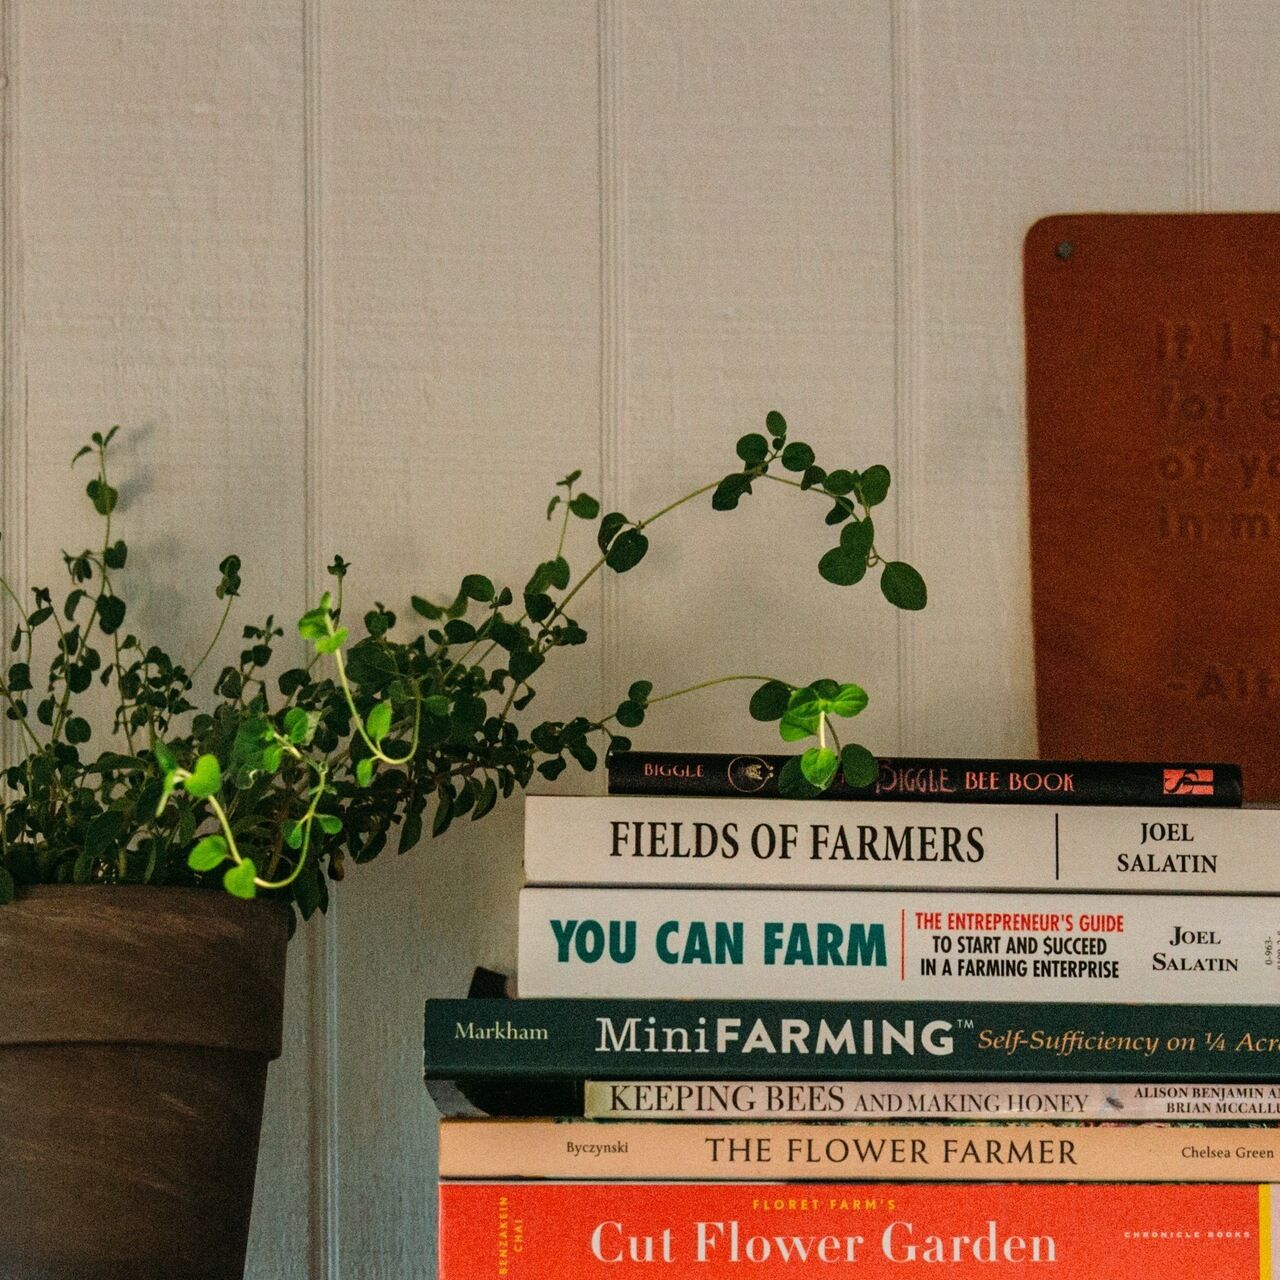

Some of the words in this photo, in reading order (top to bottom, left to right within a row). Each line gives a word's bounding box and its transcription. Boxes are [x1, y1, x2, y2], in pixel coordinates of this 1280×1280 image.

[1160, 383, 1233, 421] for
[1158, 443, 1209, 482] of
[1158, 505, 1204, 540] in
[643, 763, 705, 779] BIGGLE
[965, 771, 1000, 791] BEE
[1009, 772, 1075, 792] BOOK
[610, 820, 740, 859] FIELDS
[751, 823, 799, 860] OF
[810, 824, 985, 863] FARMERS
[1140, 822, 1194, 845] JOEL
[1117, 853, 1218, 874] SALATIN
[915, 912, 942, 930] THE
[947, 912, 1073, 932] ENTREPRENEUR'S
[1079, 914, 1124, 933] GUIDE
[550, 919, 637, 964] YOU
[656, 920, 743, 965] CAN
[764, 922, 888, 967] FARM
[932, 935, 952, 953] TO
[957, 936, 1001, 954] START
[1006, 936, 1038, 955] AND
[1169, 926, 1222, 947] JOEL
[921, 958, 936, 976] IN
[941, 958, 952, 976] A
[958, 959, 1028, 977] FARMING
[1033, 960, 1119, 978] ENTERPRISE
[1152, 952, 1239, 972] SALATIN
[454, 1021, 548, 1041] Markham
[978, 1029, 1159, 1057] Self-Sufficiency
[1167, 1035, 1197, 1051] on
[609, 1085, 755, 1112] KEEPING
[766, 1085, 845, 1113] BEES
[854, 1093, 904, 1112] AND
[908, 1094, 1000, 1113] MAKING
[1007, 1094, 1089, 1114] HONEY
[1133, 1086, 1190, 1099] ALISON
[1192, 1086, 1265, 1100] BENJAMIN
[1166, 1102, 1211, 1115] BRIAN
[566, 1140, 629, 1157] Byczynski
[705, 1137, 772, 1163] THE
[787, 1138, 929, 1165] FLOWER
[943, 1139, 1078, 1165] FARMER
[1181, 1146, 1231, 1160] Chelsea
[1235, 1146, 1274, 1160] Green
[752, 1199, 819, 1211] FLORET
[830, 1199, 895, 1211] FARM'S
[498, 1196, 509, 1276] BENZAKEIN
[514, 1218, 523, 1253] CHAI
[591, 1220, 676, 1263] Cut
[692, 1220, 865, 1263] Flower
[881, 1221, 1058, 1264] Garden
[1124, 1230, 1201, 1239] CHRONICLE
[1206, 1230, 1251, 1239] BOOKS
